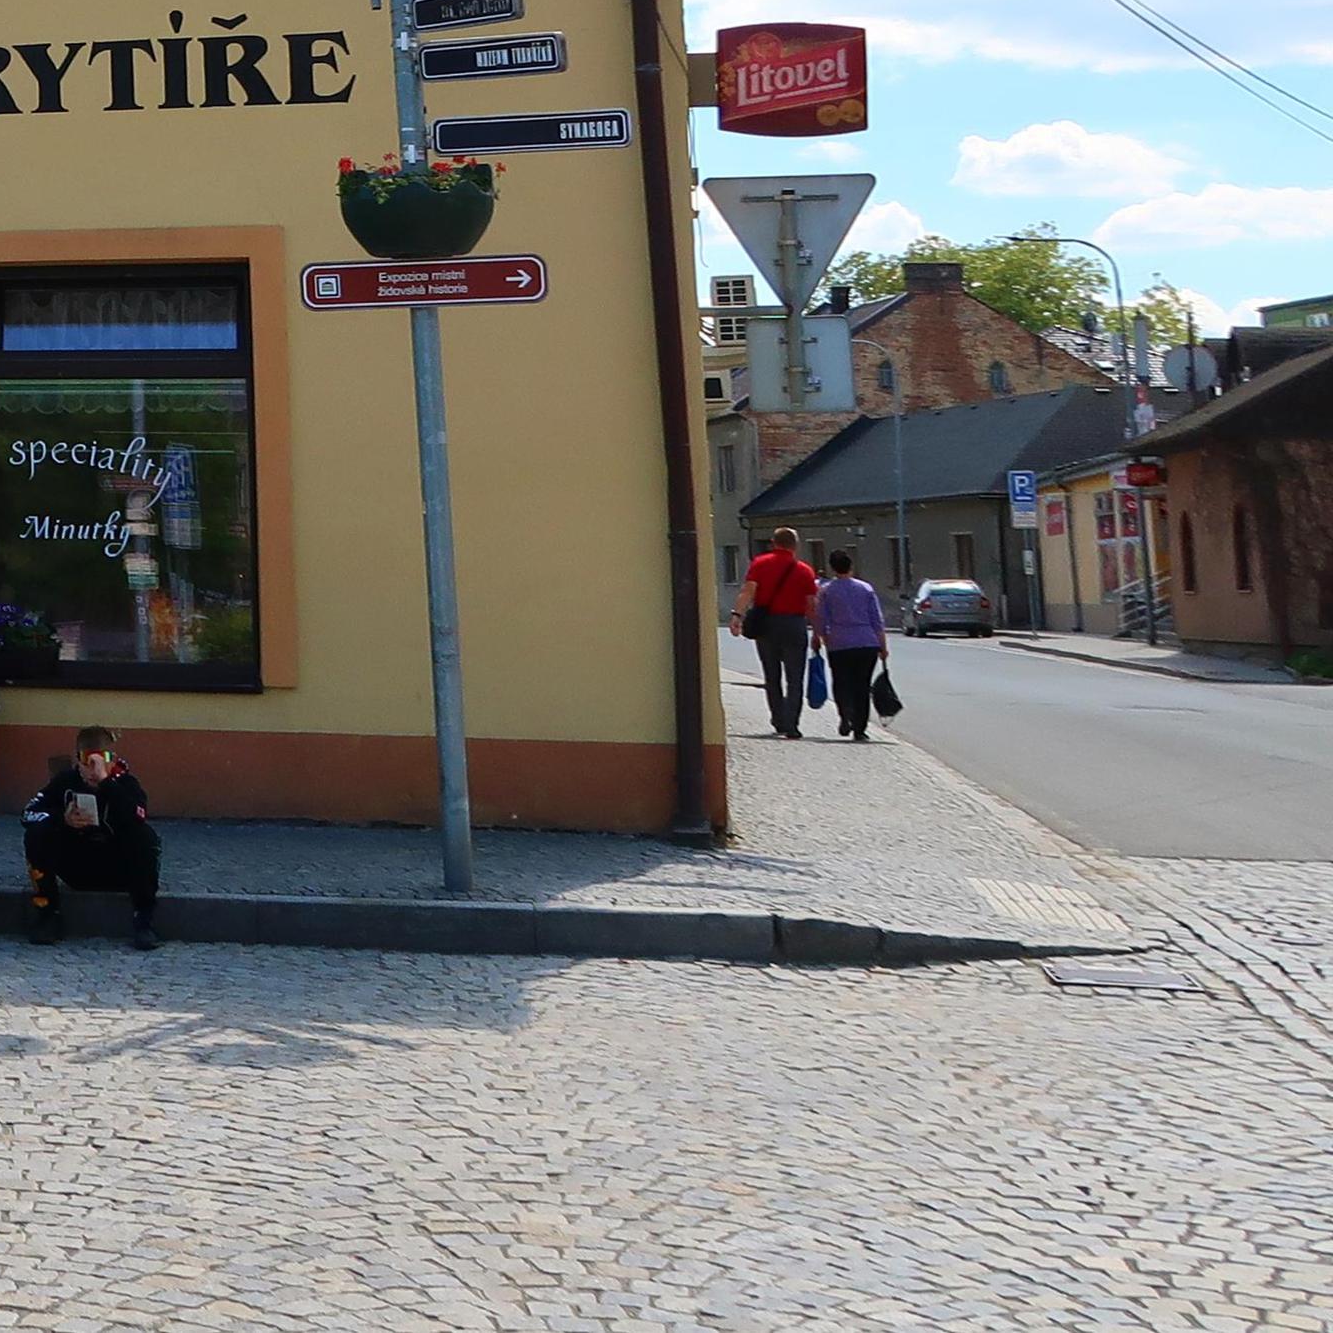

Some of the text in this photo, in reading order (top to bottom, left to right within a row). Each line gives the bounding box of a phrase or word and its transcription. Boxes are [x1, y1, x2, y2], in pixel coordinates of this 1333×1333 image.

[736, 48, 850, 107] Litovel
[559, 120, 619, 139] SYNAGOGA
[378, 271, 429, 283] Expozice
[428, 283, 468, 294] historie
[8, 436, 173, 511] speciality
[19, 510, 132, 557] Minutky
